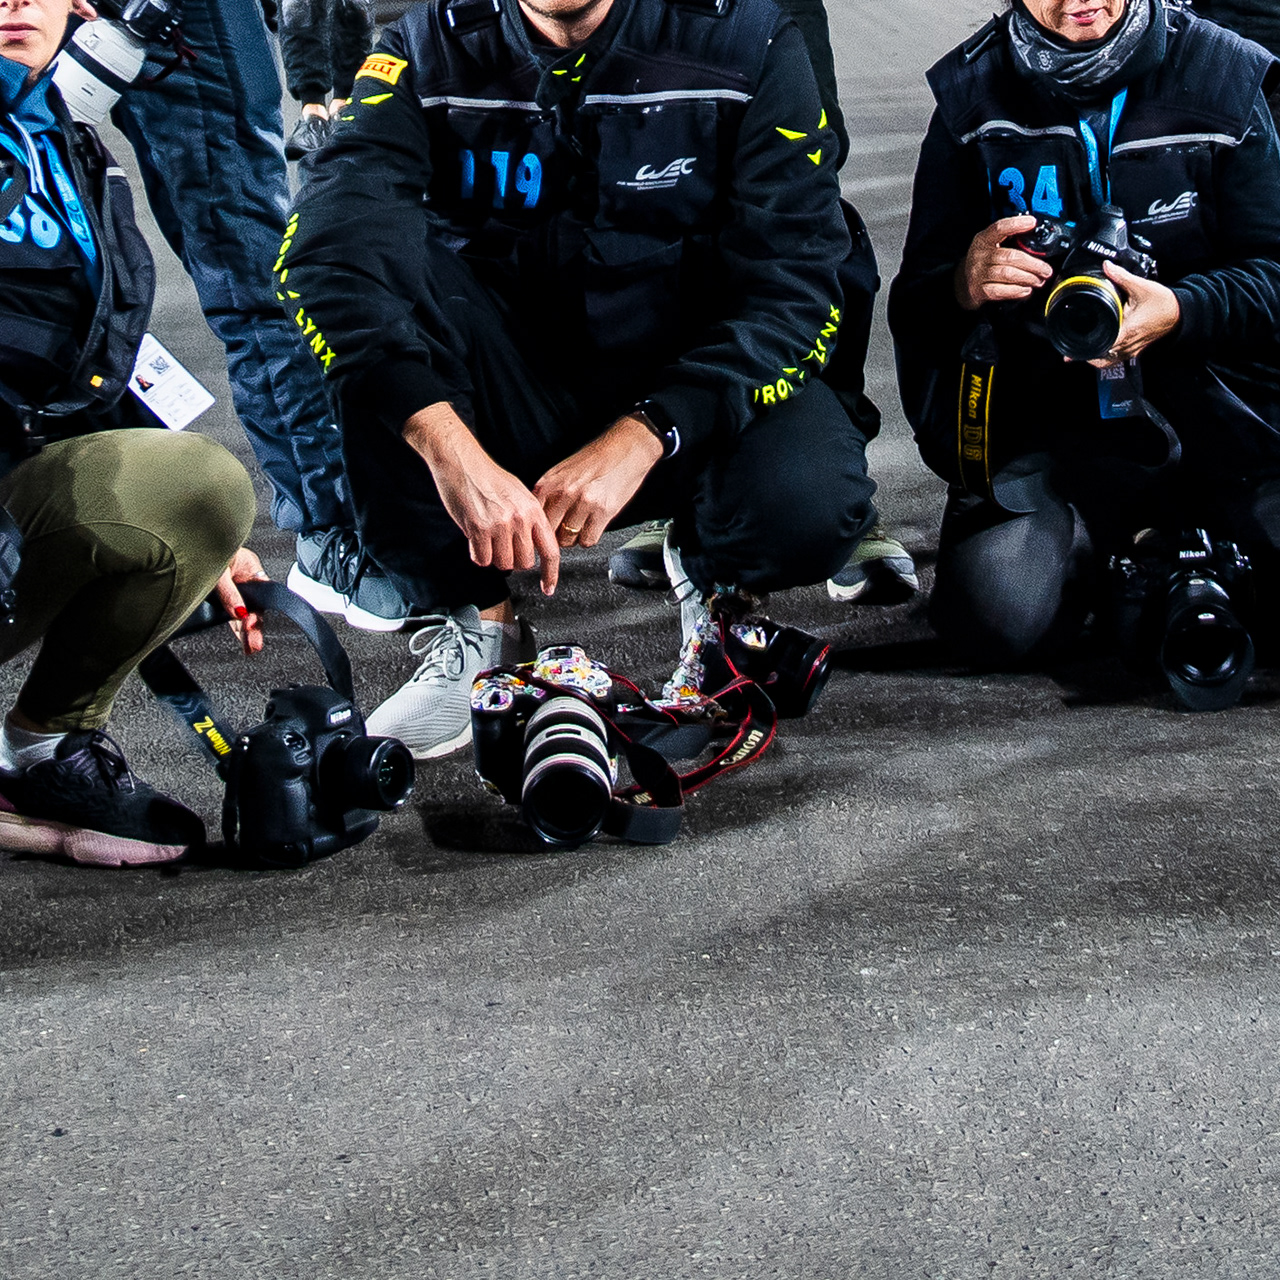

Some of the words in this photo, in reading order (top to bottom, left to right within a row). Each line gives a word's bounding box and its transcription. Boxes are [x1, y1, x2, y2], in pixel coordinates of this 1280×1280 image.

[459, 149, 542, 209] 119
[635, 157, 697, 180] WEC
[998, 165, 1063, 218] 34
[1148, 191, 1198, 215] WEC
[1087, 241, 1117, 258] Nikon
[295, 307, 336, 374] LYNX
[969, 374, 983, 419] Nikon
[1179, 550, 1206, 559] Nikon
[720, 729, 764, 766] Canon
